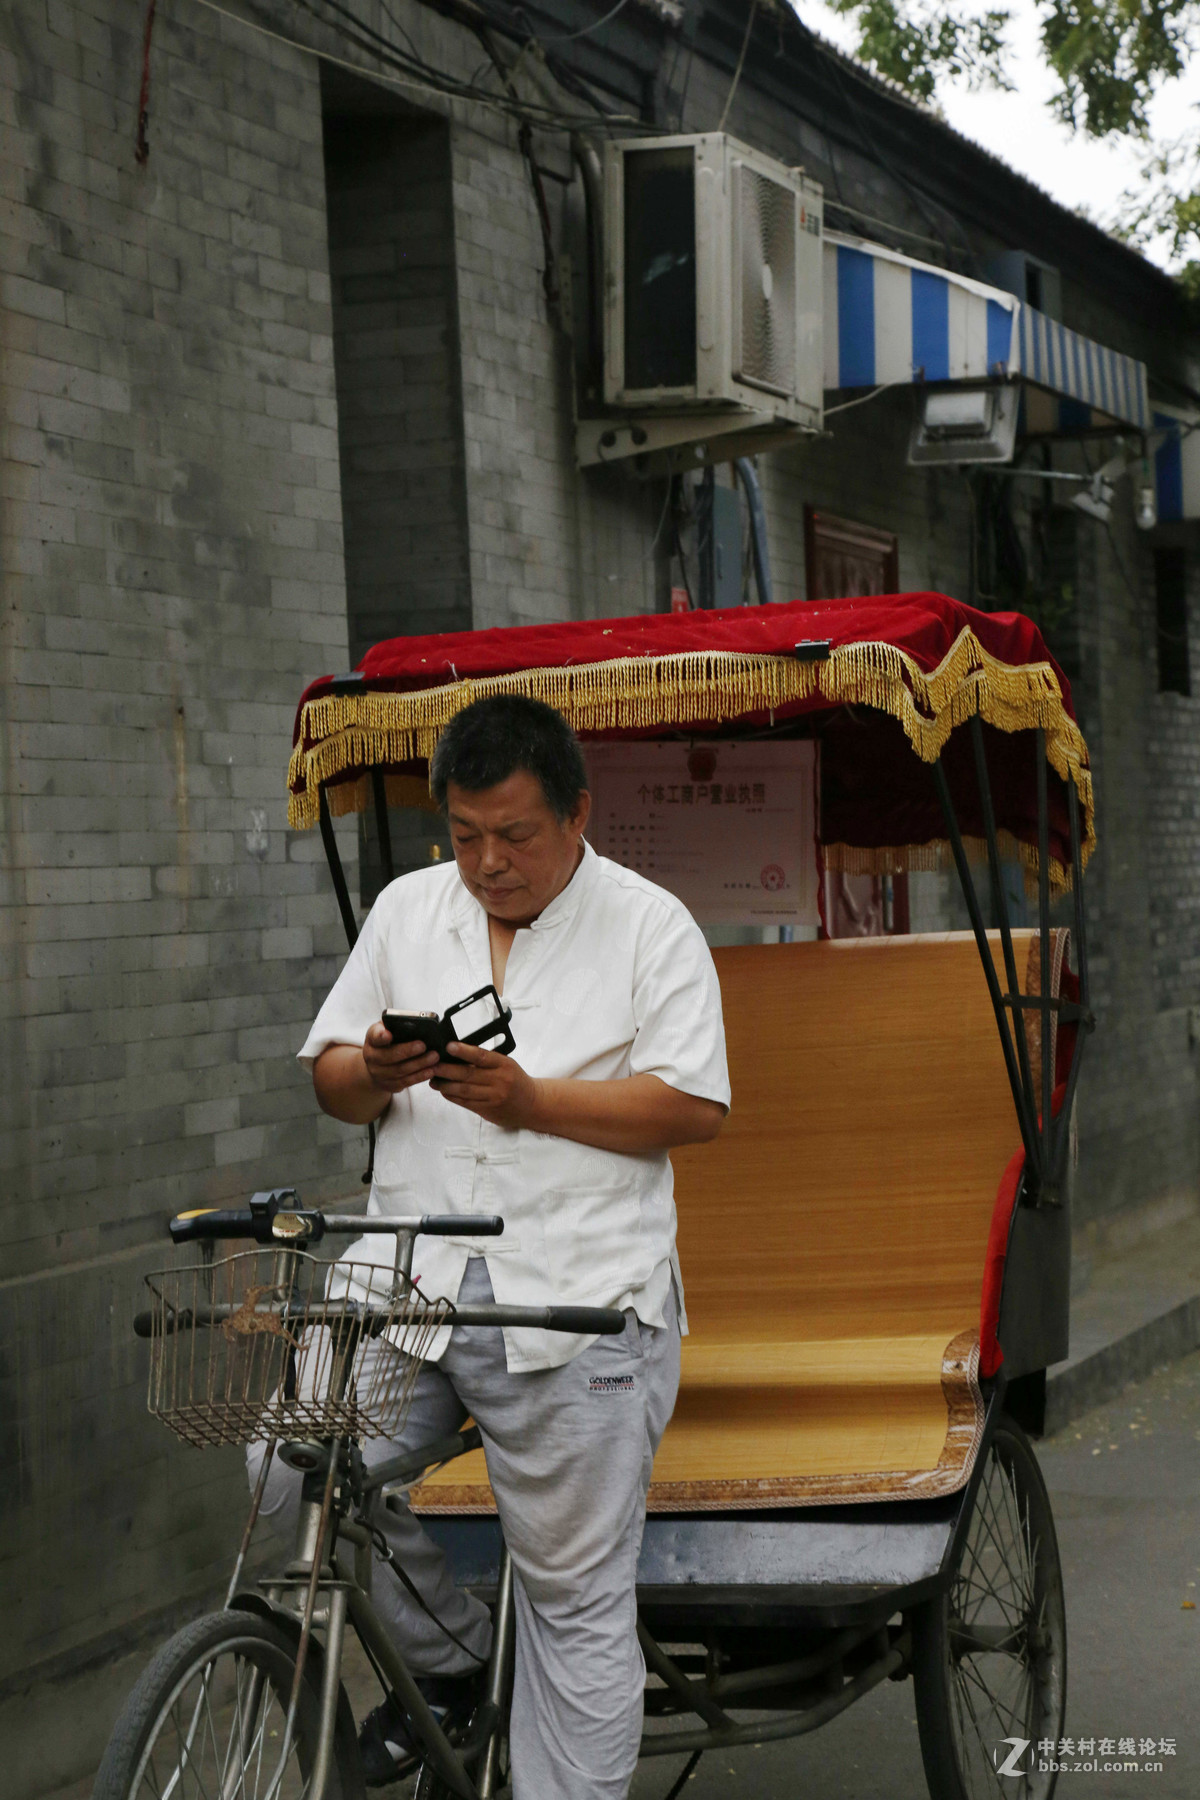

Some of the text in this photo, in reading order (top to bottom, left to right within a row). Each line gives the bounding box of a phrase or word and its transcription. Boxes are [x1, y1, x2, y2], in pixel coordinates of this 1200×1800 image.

[637, 783, 765, 805] 个体工商户营业执照
